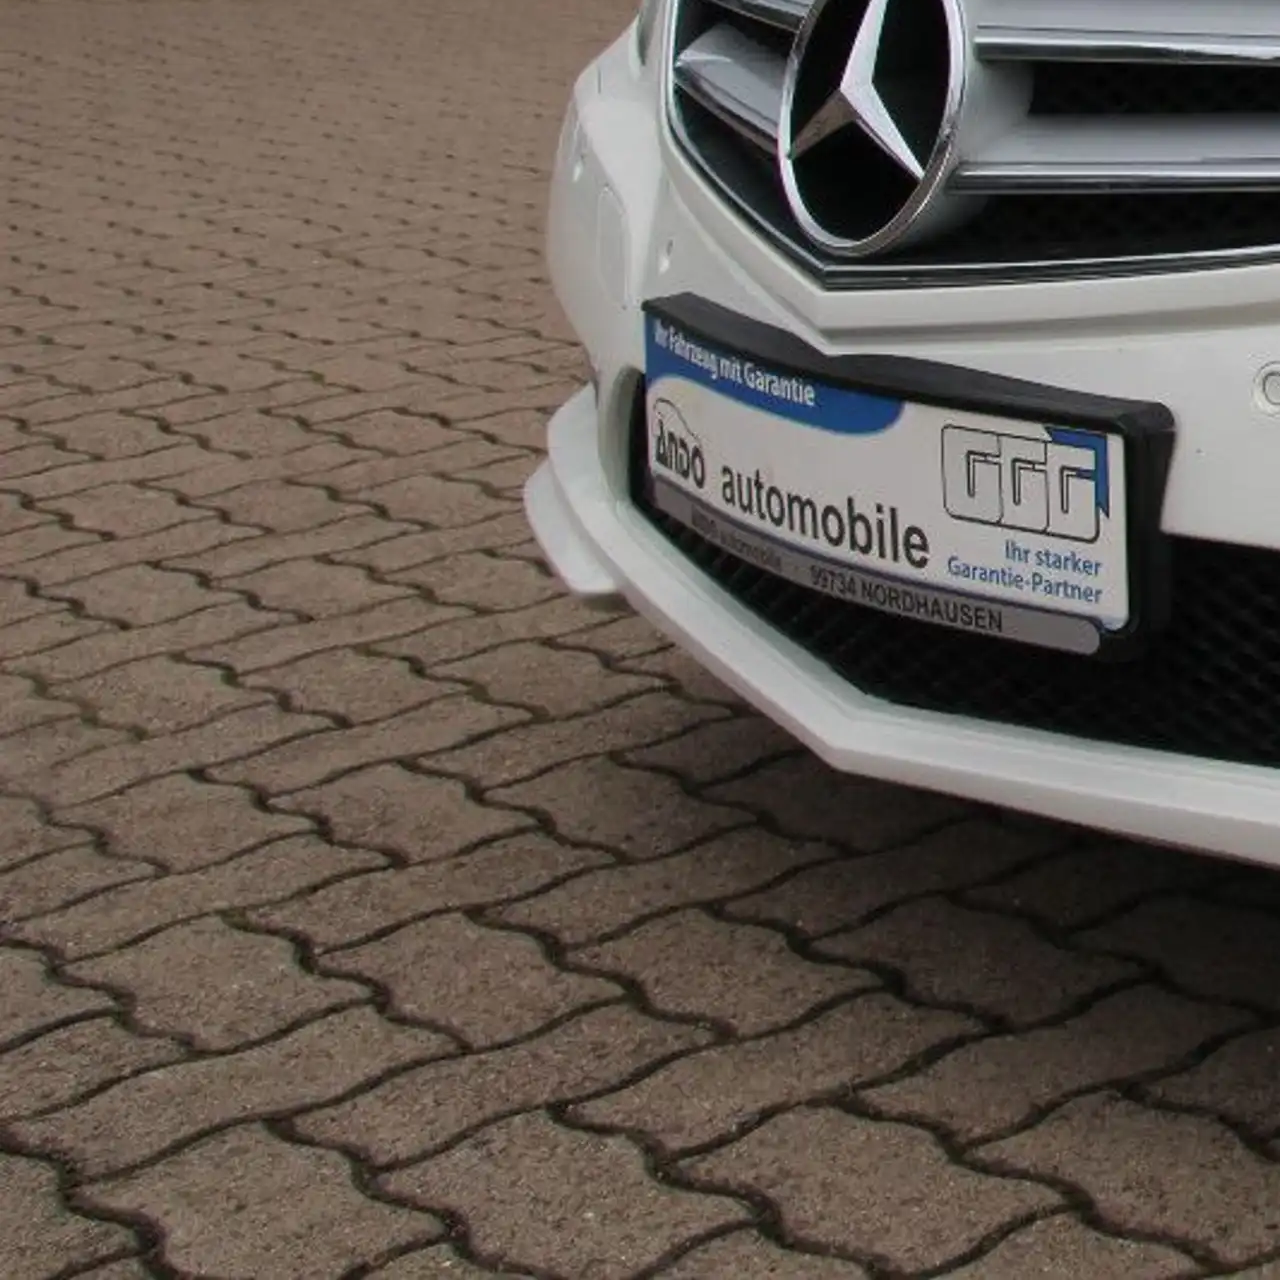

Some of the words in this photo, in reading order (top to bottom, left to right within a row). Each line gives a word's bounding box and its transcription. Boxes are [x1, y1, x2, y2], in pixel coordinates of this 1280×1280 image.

[720, 356, 743, 384] mit
[744, 362, 816, 406] Garantie
[721, 465, 930, 569] automobile
[947, 556, 1103, 603] Garantie-Partner
[1005, 539, 1031, 564] Ihr
[1034, 549, 1103, 577] starker
[811, 565, 857, 596] 99734
[861, 581, 1003, 632] NORDHAUSEN
